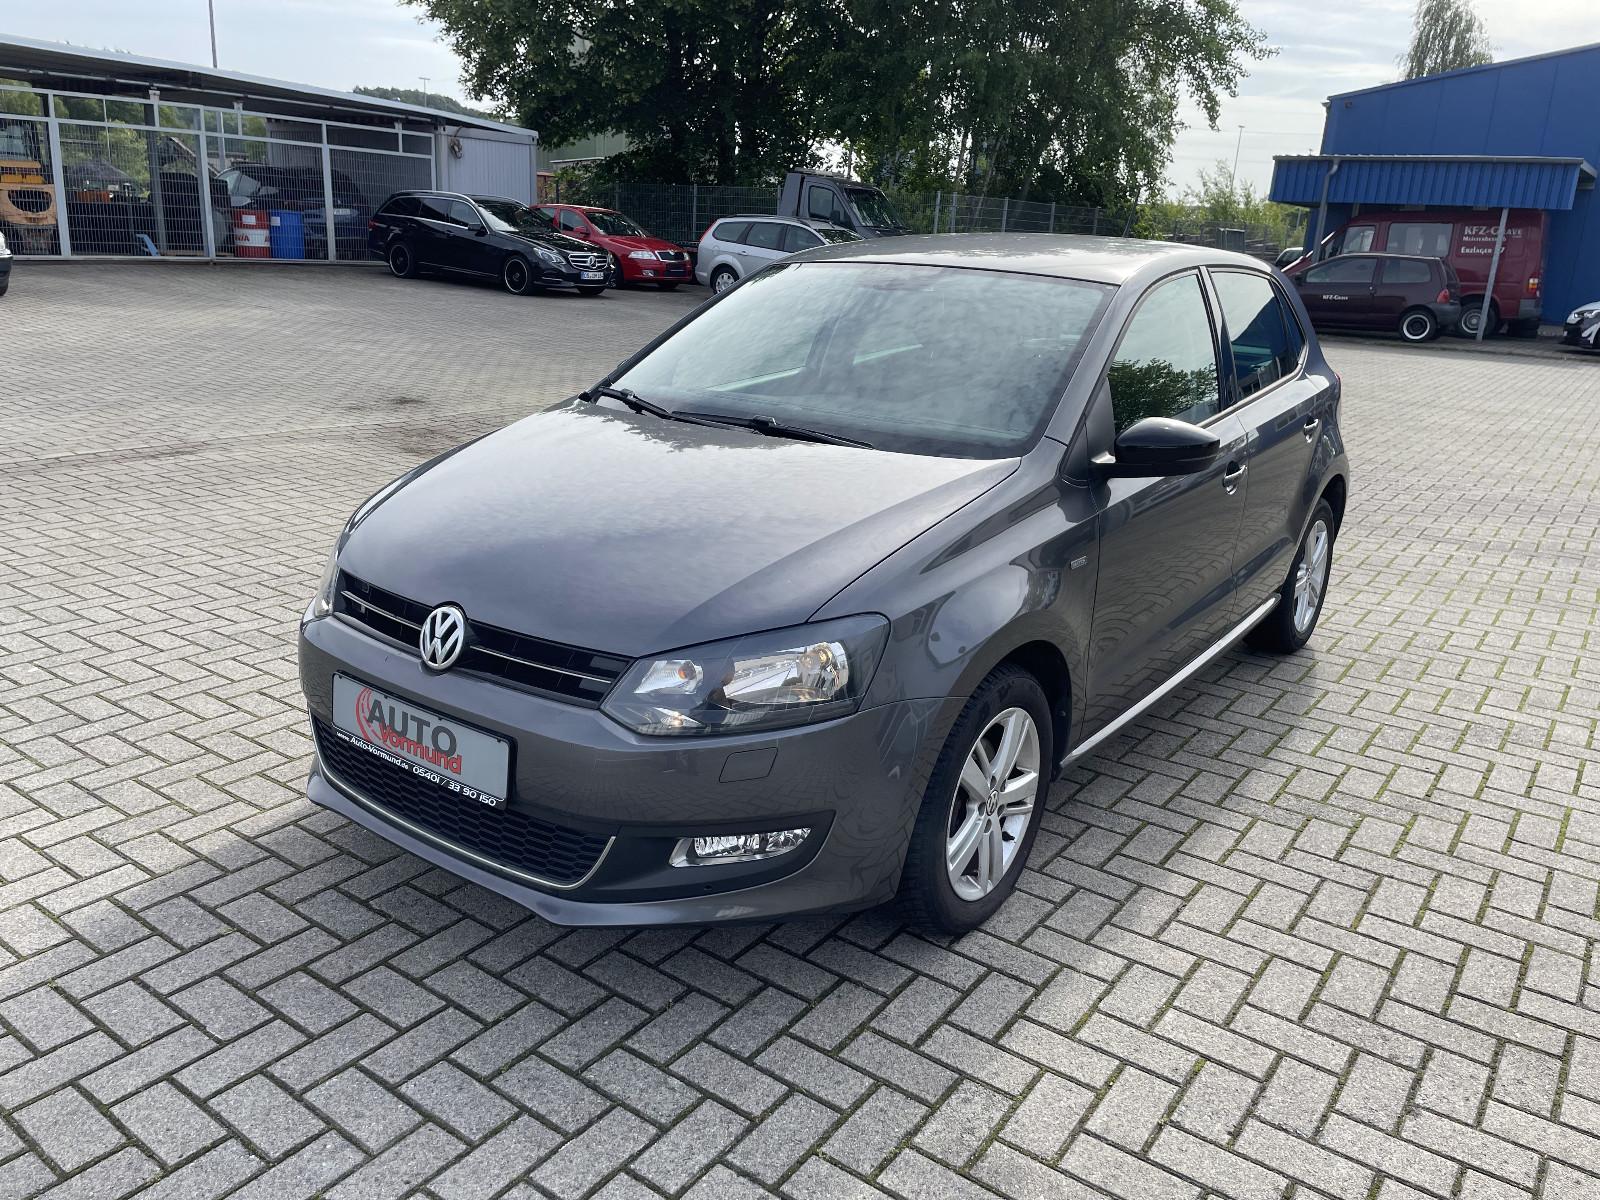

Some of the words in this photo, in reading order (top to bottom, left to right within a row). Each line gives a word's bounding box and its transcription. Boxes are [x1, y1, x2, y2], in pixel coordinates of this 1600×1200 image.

[420, 605, 465, 671] VW
[366, 699, 457, 758] AUTO
[379, 722, 462, 775] Vormund
[412, 766, 440, 783] 05401
[448, 780, 461, 793] 33
[462, 787, 477, 799] 90
[479, 793, 497, 806] 150
